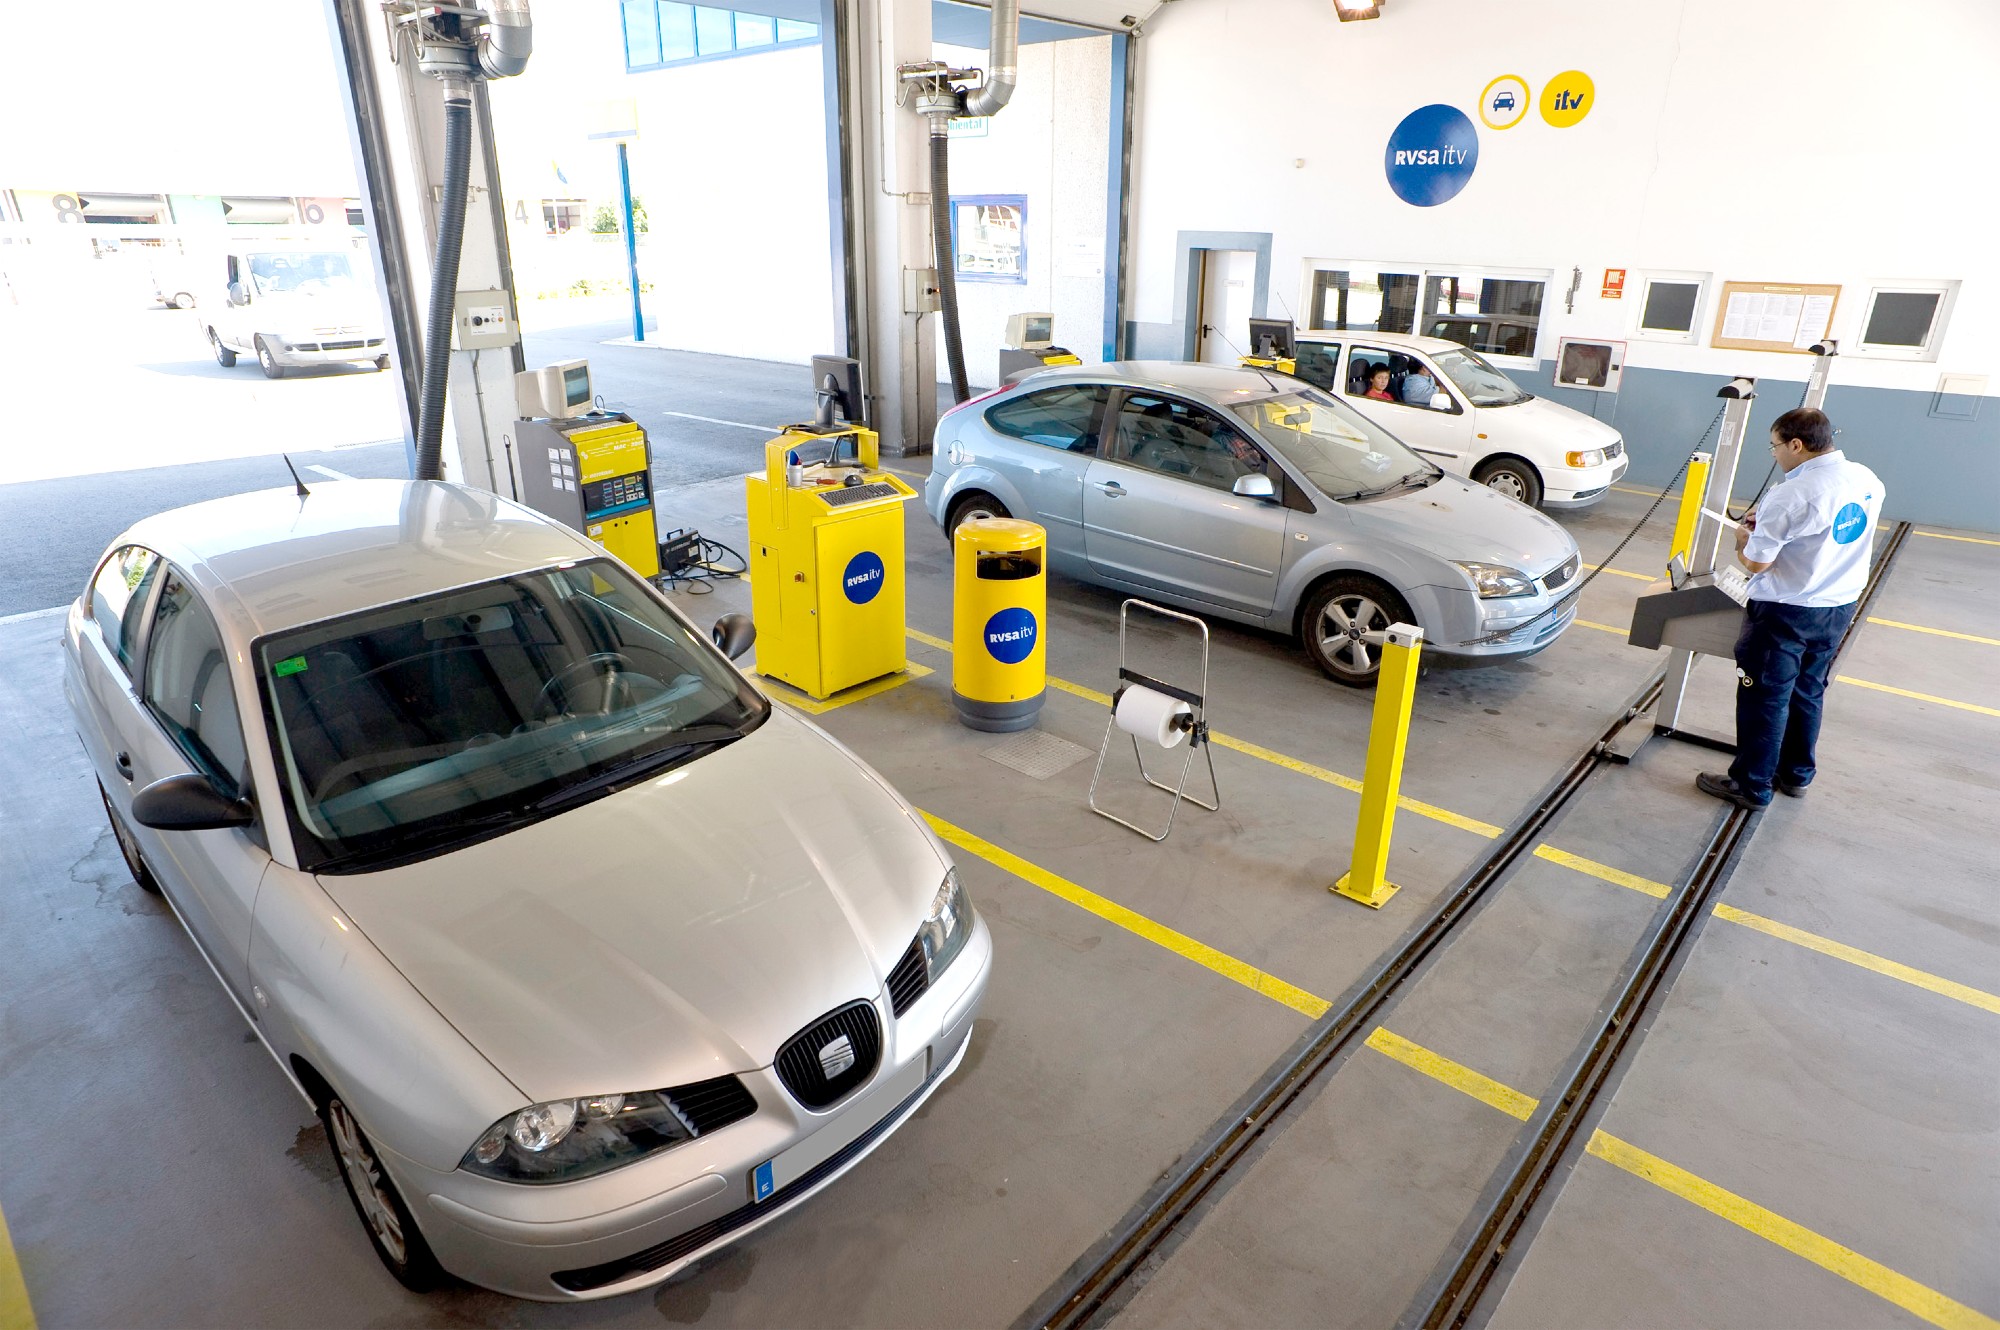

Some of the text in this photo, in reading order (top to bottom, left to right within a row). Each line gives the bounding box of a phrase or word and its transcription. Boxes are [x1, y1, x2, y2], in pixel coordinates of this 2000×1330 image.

[1554, 89, 1584, 111] itv
[1442, 145, 1467, 165] itv
[514, 199, 529, 225] 4
[869, 568, 881, 580] itv
[1020, 626, 1034, 639] itv
[761, 1182, 770, 1193] E
